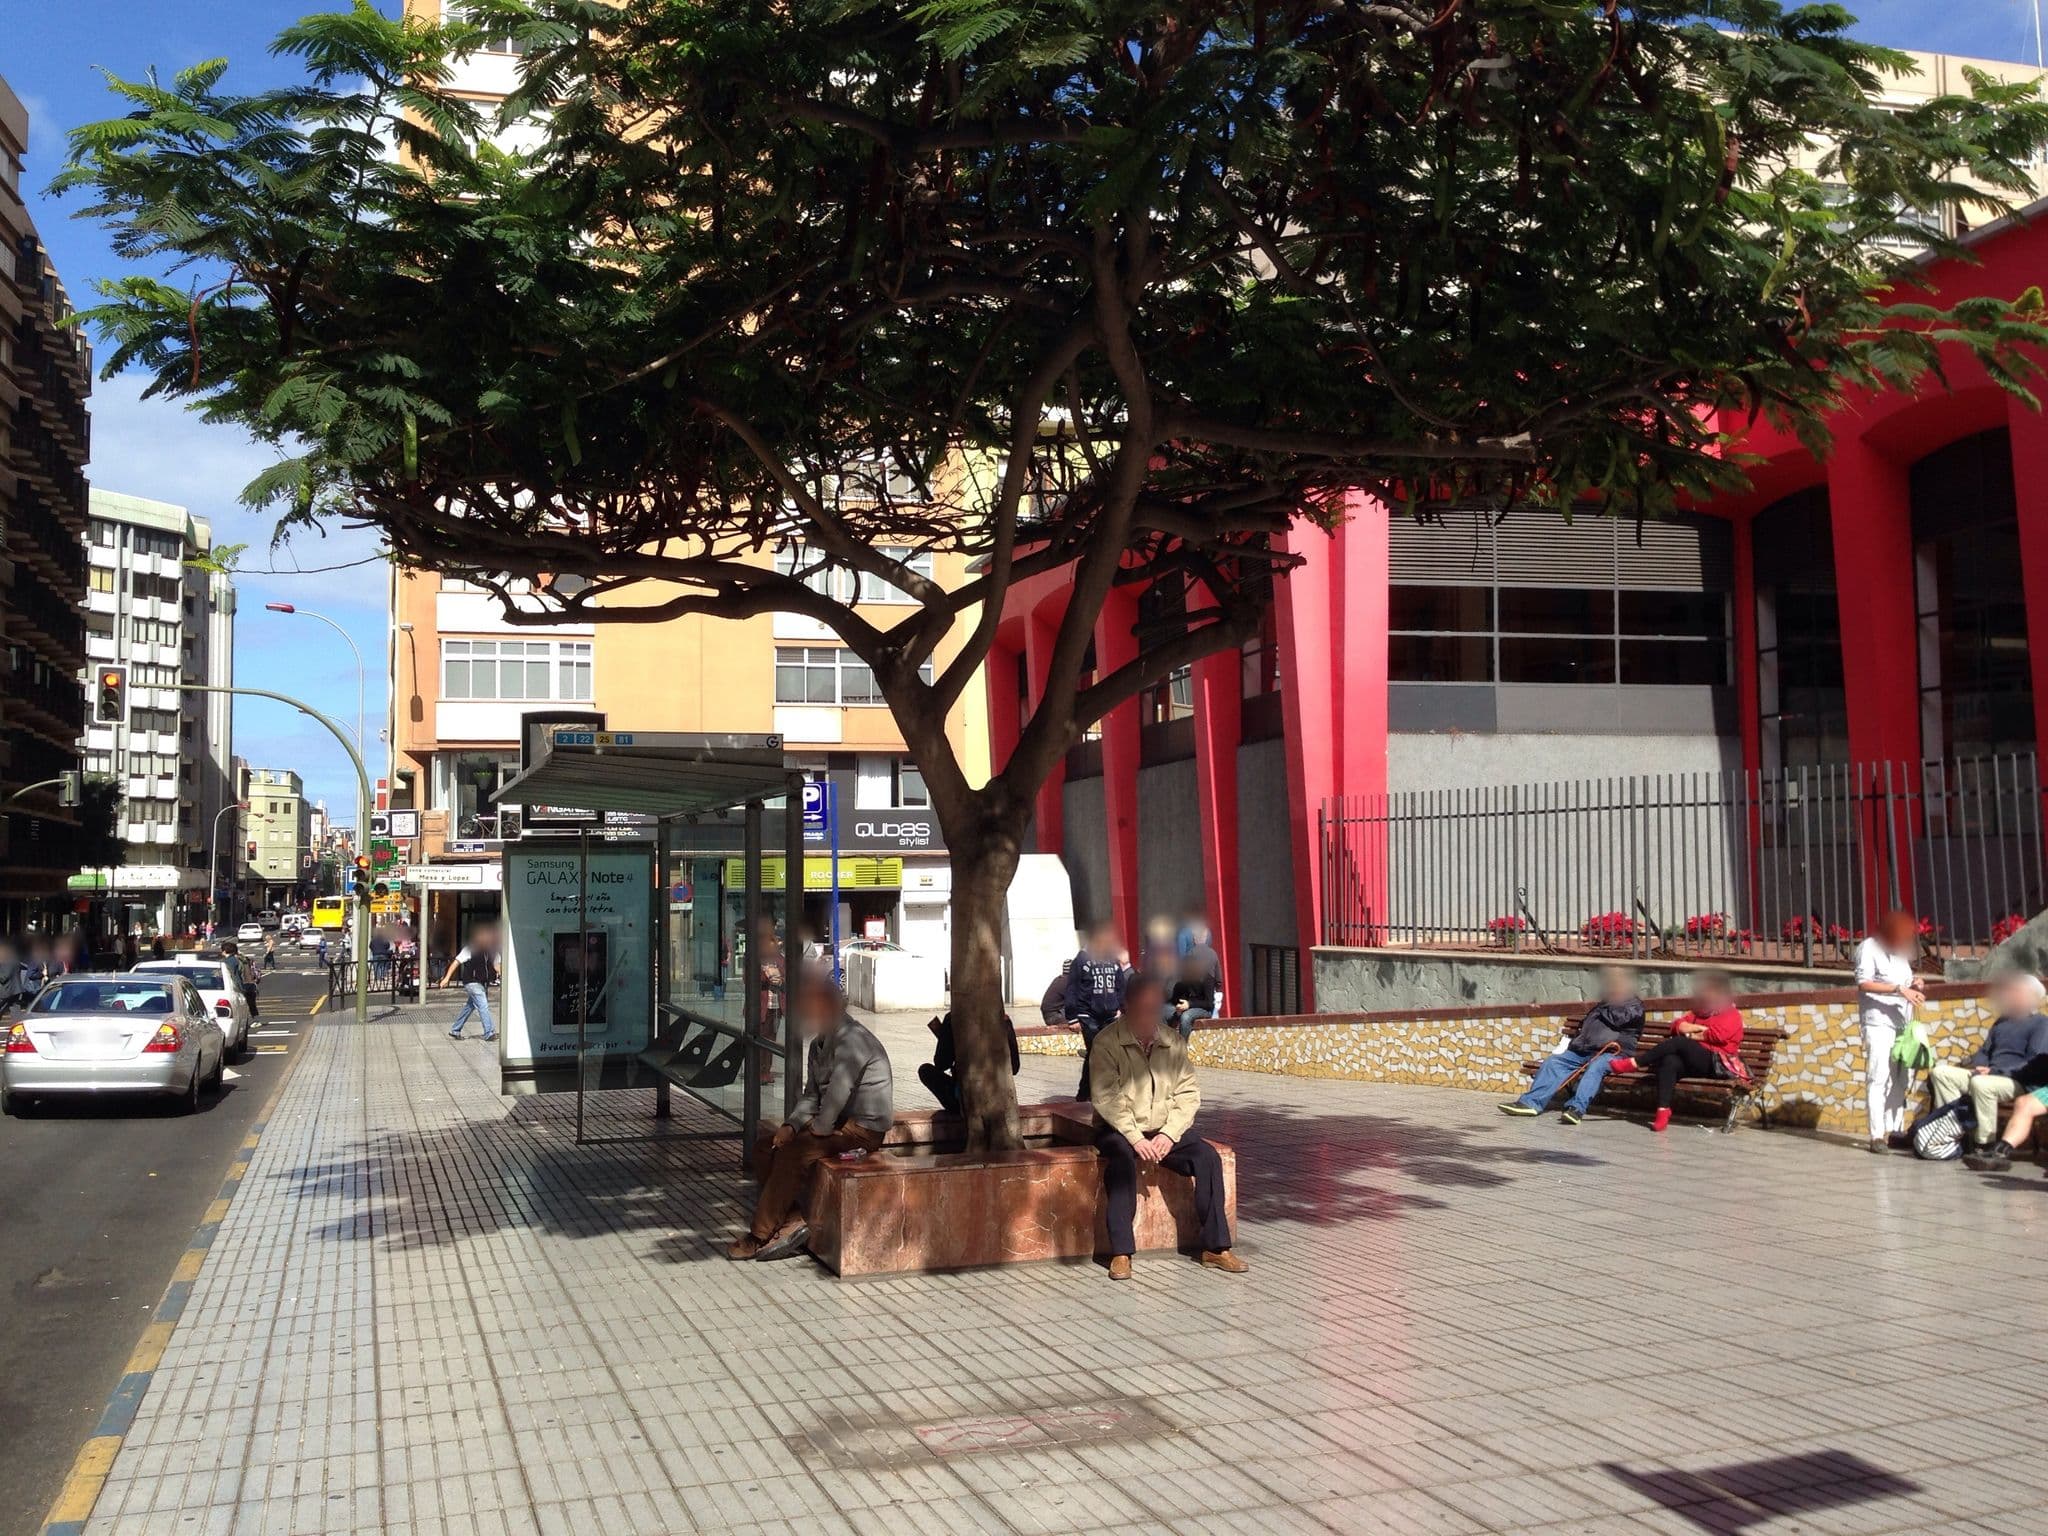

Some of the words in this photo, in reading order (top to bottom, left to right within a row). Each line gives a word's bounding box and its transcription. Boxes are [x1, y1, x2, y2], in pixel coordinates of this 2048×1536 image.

[580, 735, 590, 743] 22
[600, 735, 610, 743] 25
[803, 787, 820, 810] P
[899, 837, 929, 846] stylist
[527, 859, 575, 870] Samsung
[591, 871, 625, 884] Note
